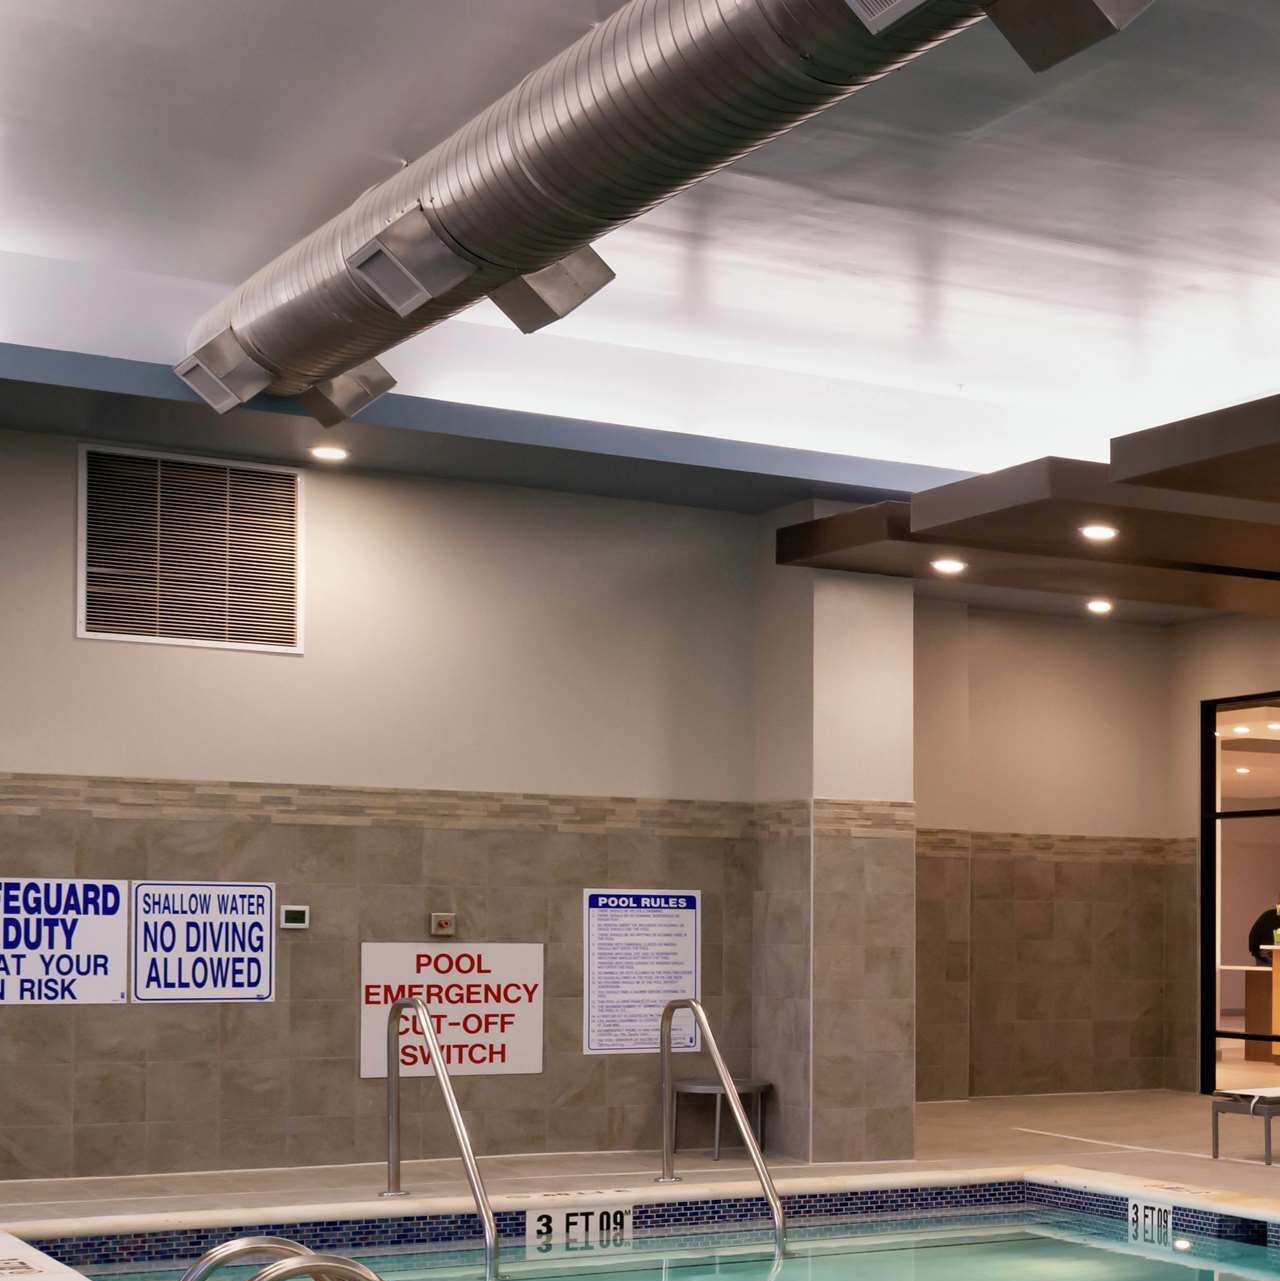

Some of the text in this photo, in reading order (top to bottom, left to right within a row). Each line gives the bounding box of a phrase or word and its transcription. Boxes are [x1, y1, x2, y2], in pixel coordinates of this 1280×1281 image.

[0, 882, 120, 915] EGUARD
[143, 893, 265, 915] SHALLOW WATER
[598, 896, 687, 908] POOL RULES
[3, 917, 79, 950] DUTY
[144, 921, 264, 952] NO DIVING
[40, 954, 109, 976] YOUR
[146, 957, 262, 989] ALLOWED
[415, 954, 491, 974] POOL
[19, 978, 77, 1000] RISK
[364, 983, 539, 1005] EMERGENCY
[536, 1214, 553, 1235] 3
[565, 1211, 594, 1233] FT
[1132, 1203, 1139, 1224] 3
[1144, 1205, 1156, 1226] FT
